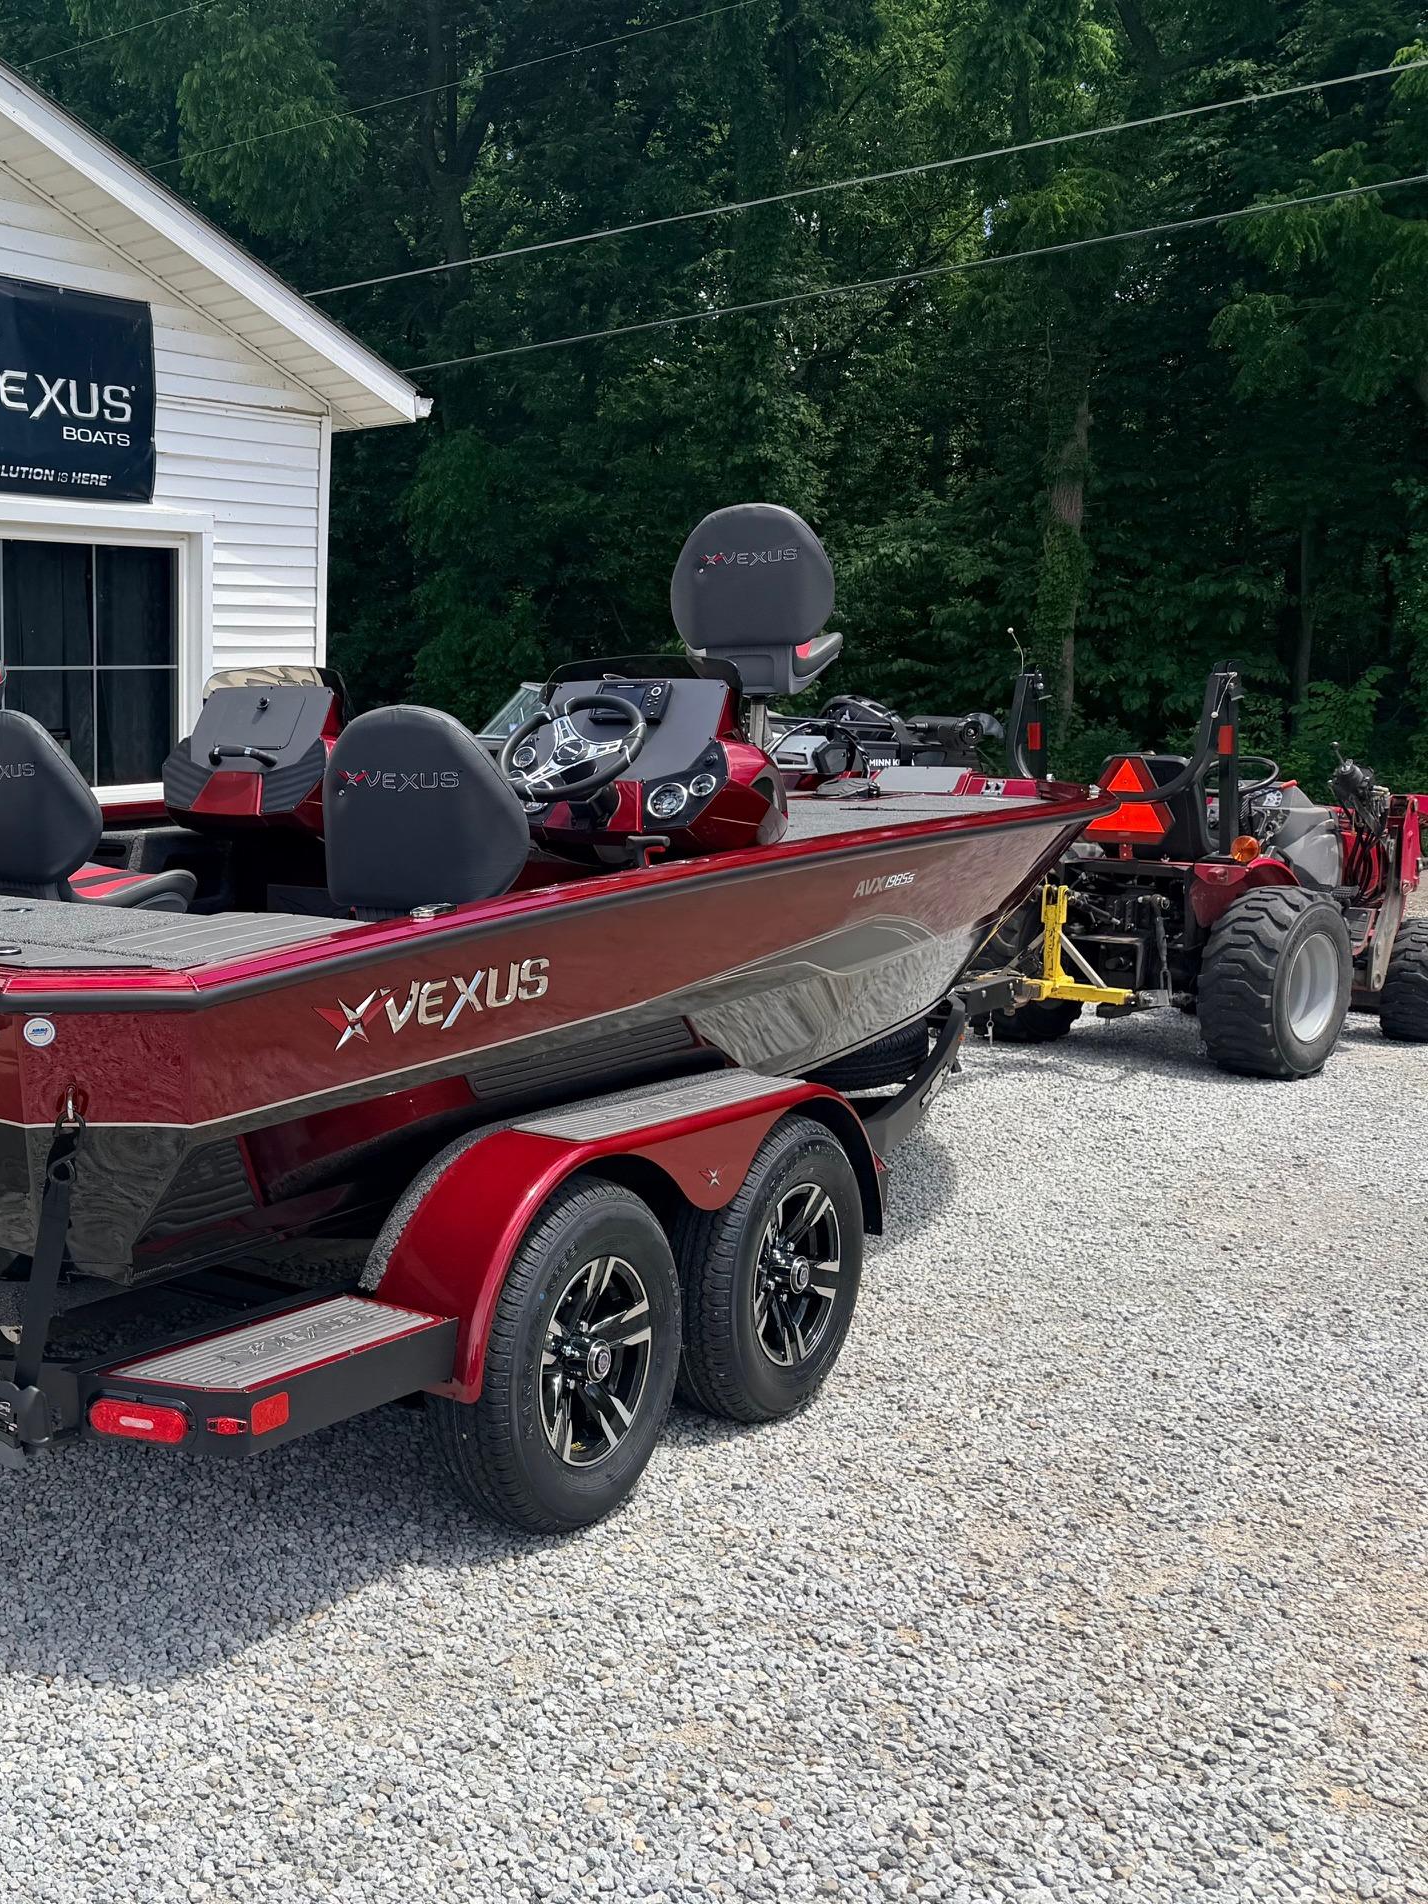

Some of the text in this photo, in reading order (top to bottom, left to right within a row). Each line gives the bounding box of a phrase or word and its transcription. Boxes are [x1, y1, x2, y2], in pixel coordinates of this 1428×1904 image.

[62, 426, 131, 447] BOATS
[719, 548, 798, 566] VEXUS
[869, 758, 891, 767] MINN
[362, 769, 460, 792] VEXUS
[853, 875, 886, 899] AVX
[379, 957, 550, 1034] VEXUS
